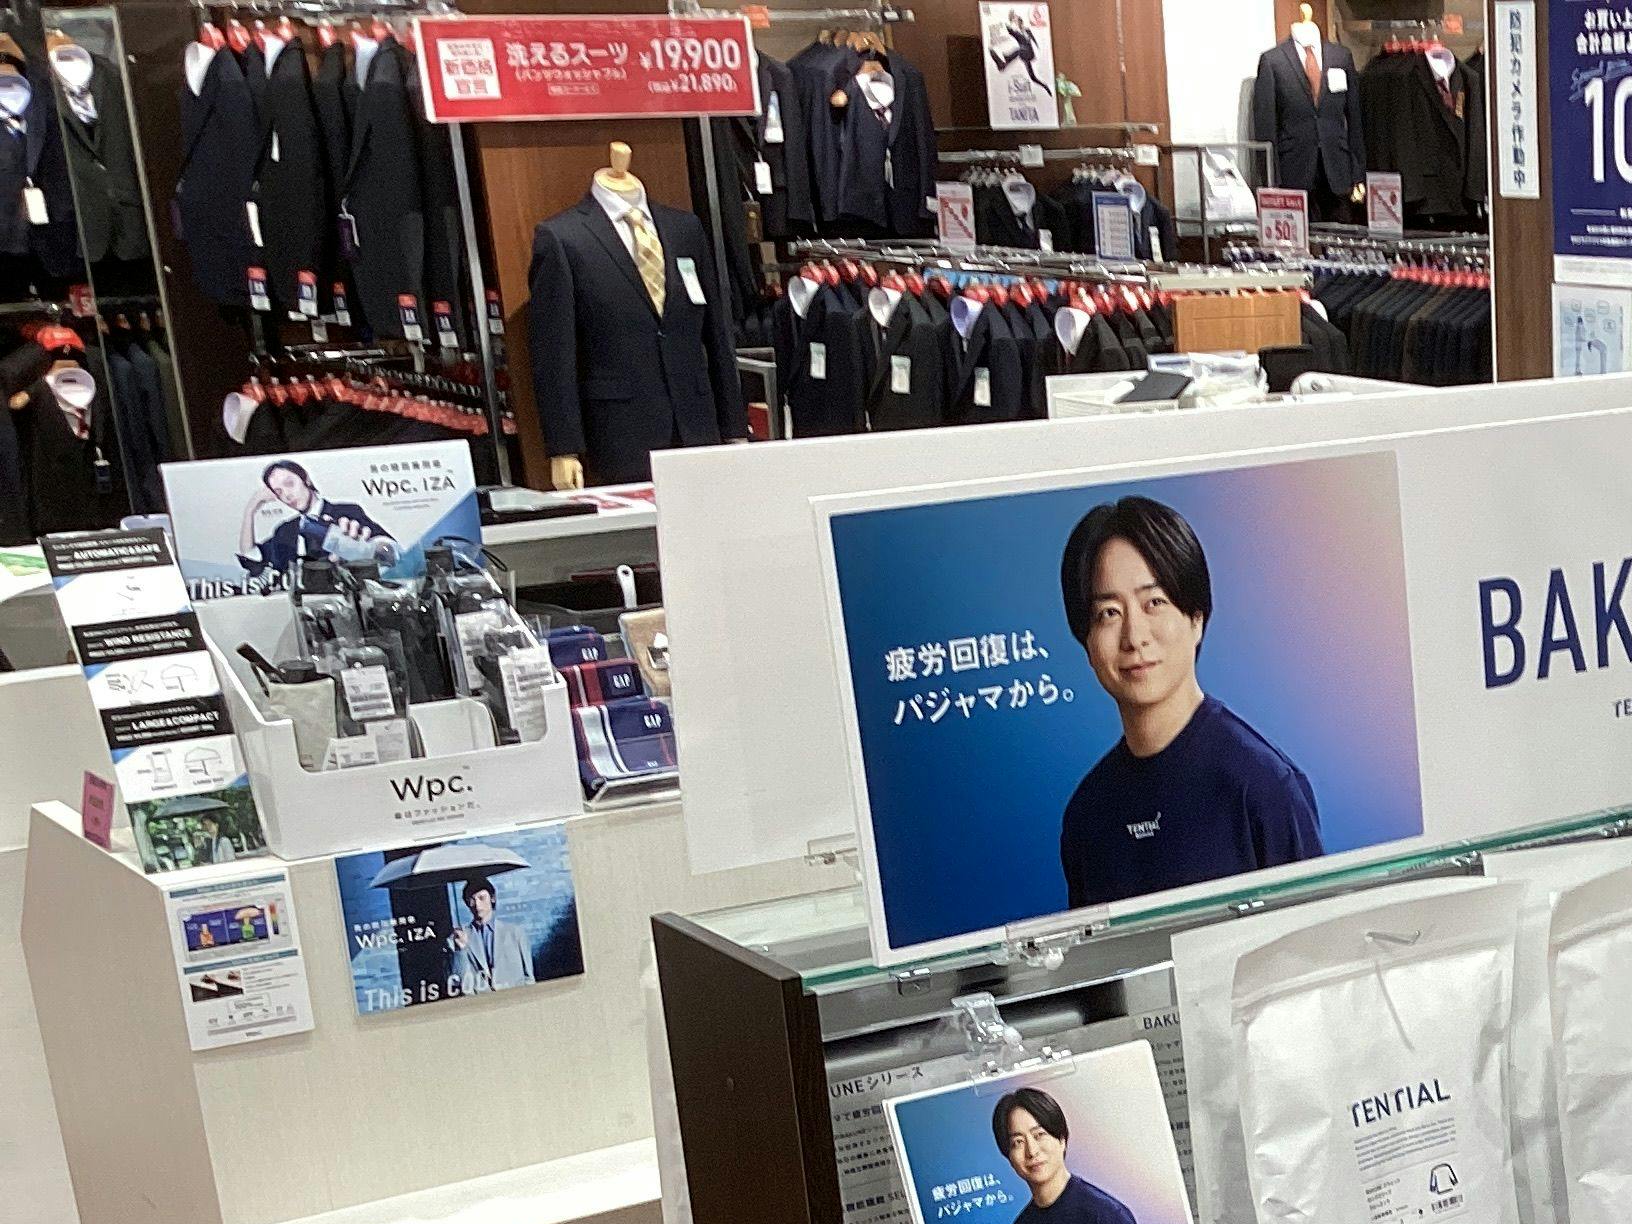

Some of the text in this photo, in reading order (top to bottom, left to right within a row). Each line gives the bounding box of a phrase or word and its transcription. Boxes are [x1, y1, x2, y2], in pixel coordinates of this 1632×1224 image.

[505, 41, 629, 68] 洗えるスーツ
[362, 475, 457, 498] Wpc. IZA
[187, 577, 236, 601] This
[241, 572, 260, 593] is
[884, 629, 1051, 683] 疲労回復は、
[893, 672, 1075, 725] パジャマから。
[389, 775, 474, 802] Wpc.
[355, 926, 436, 950] Wpc. IZA
[364, 984, 413, 1012] This
[419, 979, 440, 1002] is
[1348, 1077, 1452, 1128] TENTIAL
[931, 1173, 1002, 1203] 疲労回復は、
[937, 1189, 1015, 1219] パジャマから。
